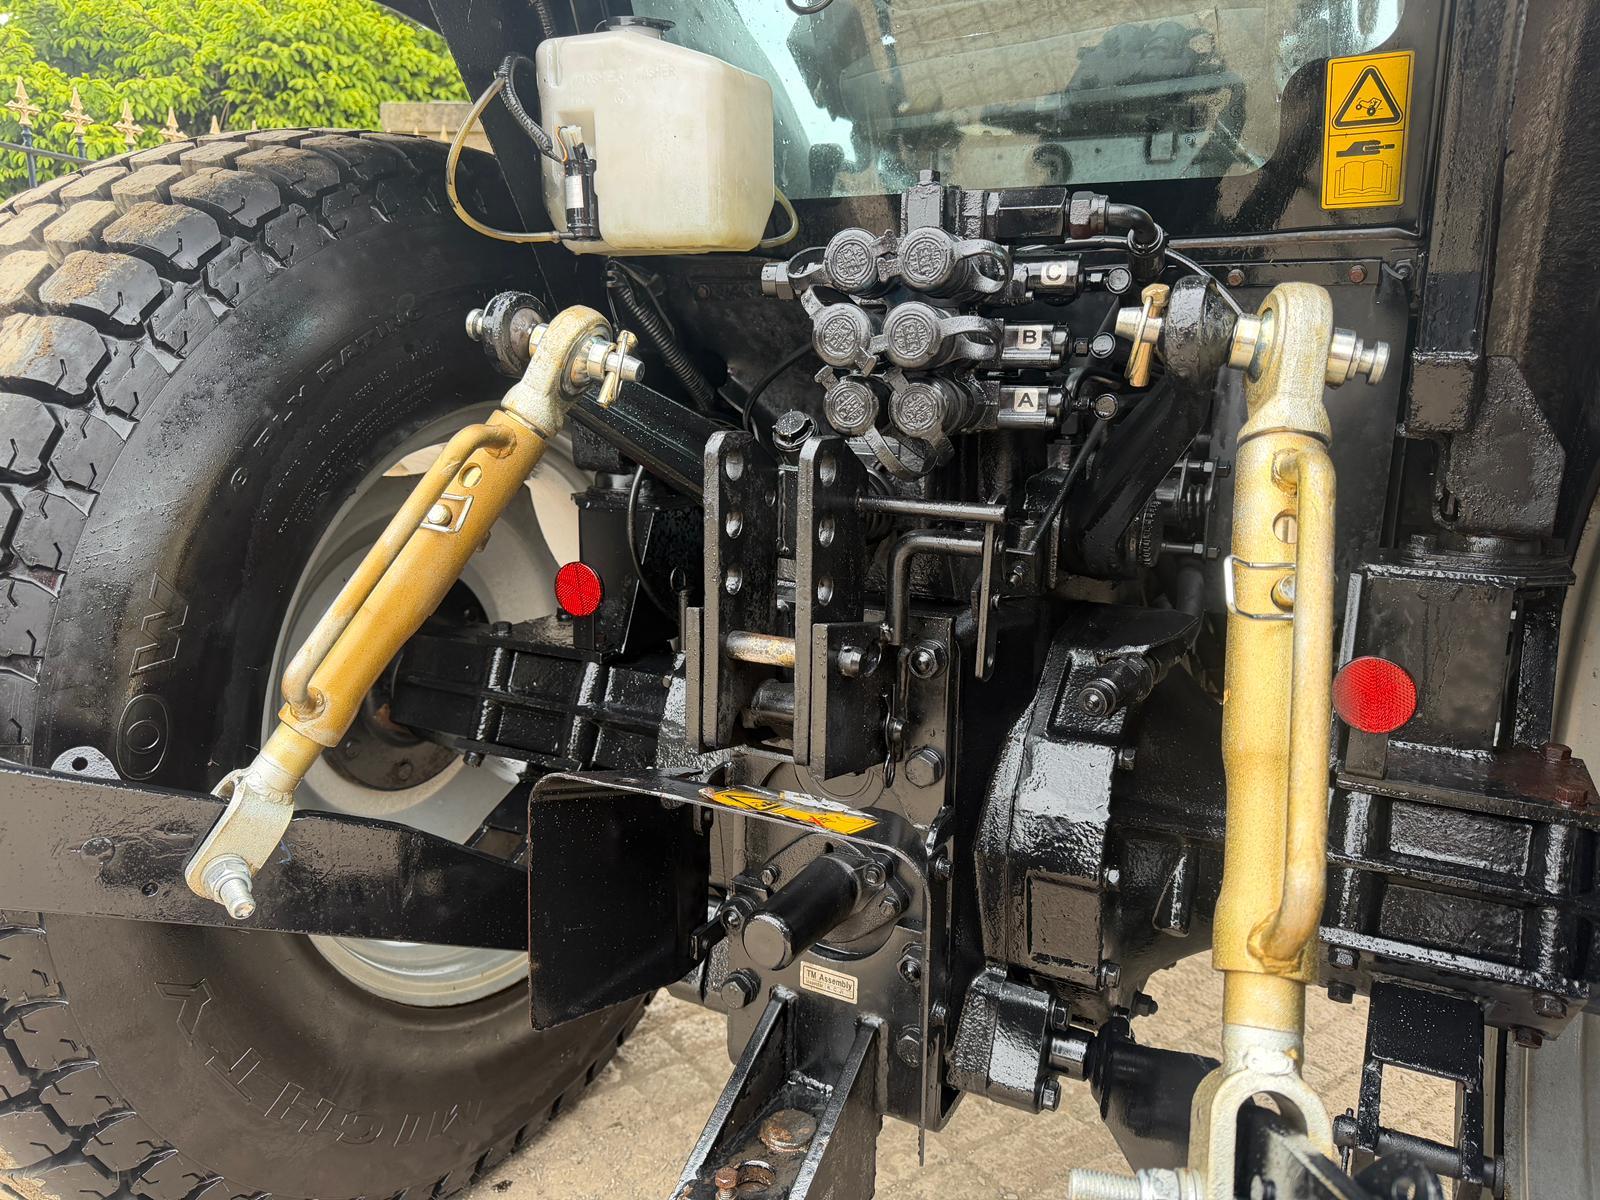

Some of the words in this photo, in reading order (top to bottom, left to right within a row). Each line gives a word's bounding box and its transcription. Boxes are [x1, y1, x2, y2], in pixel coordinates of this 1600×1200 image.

[1045, 263, 1063, 281] C
[1022, 329, 1037, 345] B
[1017, 392, 1034, 408] A
[115, 572, 189, 780] OW
[806, 969, 817, 980] TM
[819, 973, 853, 992] Assembly
[154, 978, 483, 1147] MIGHTY
